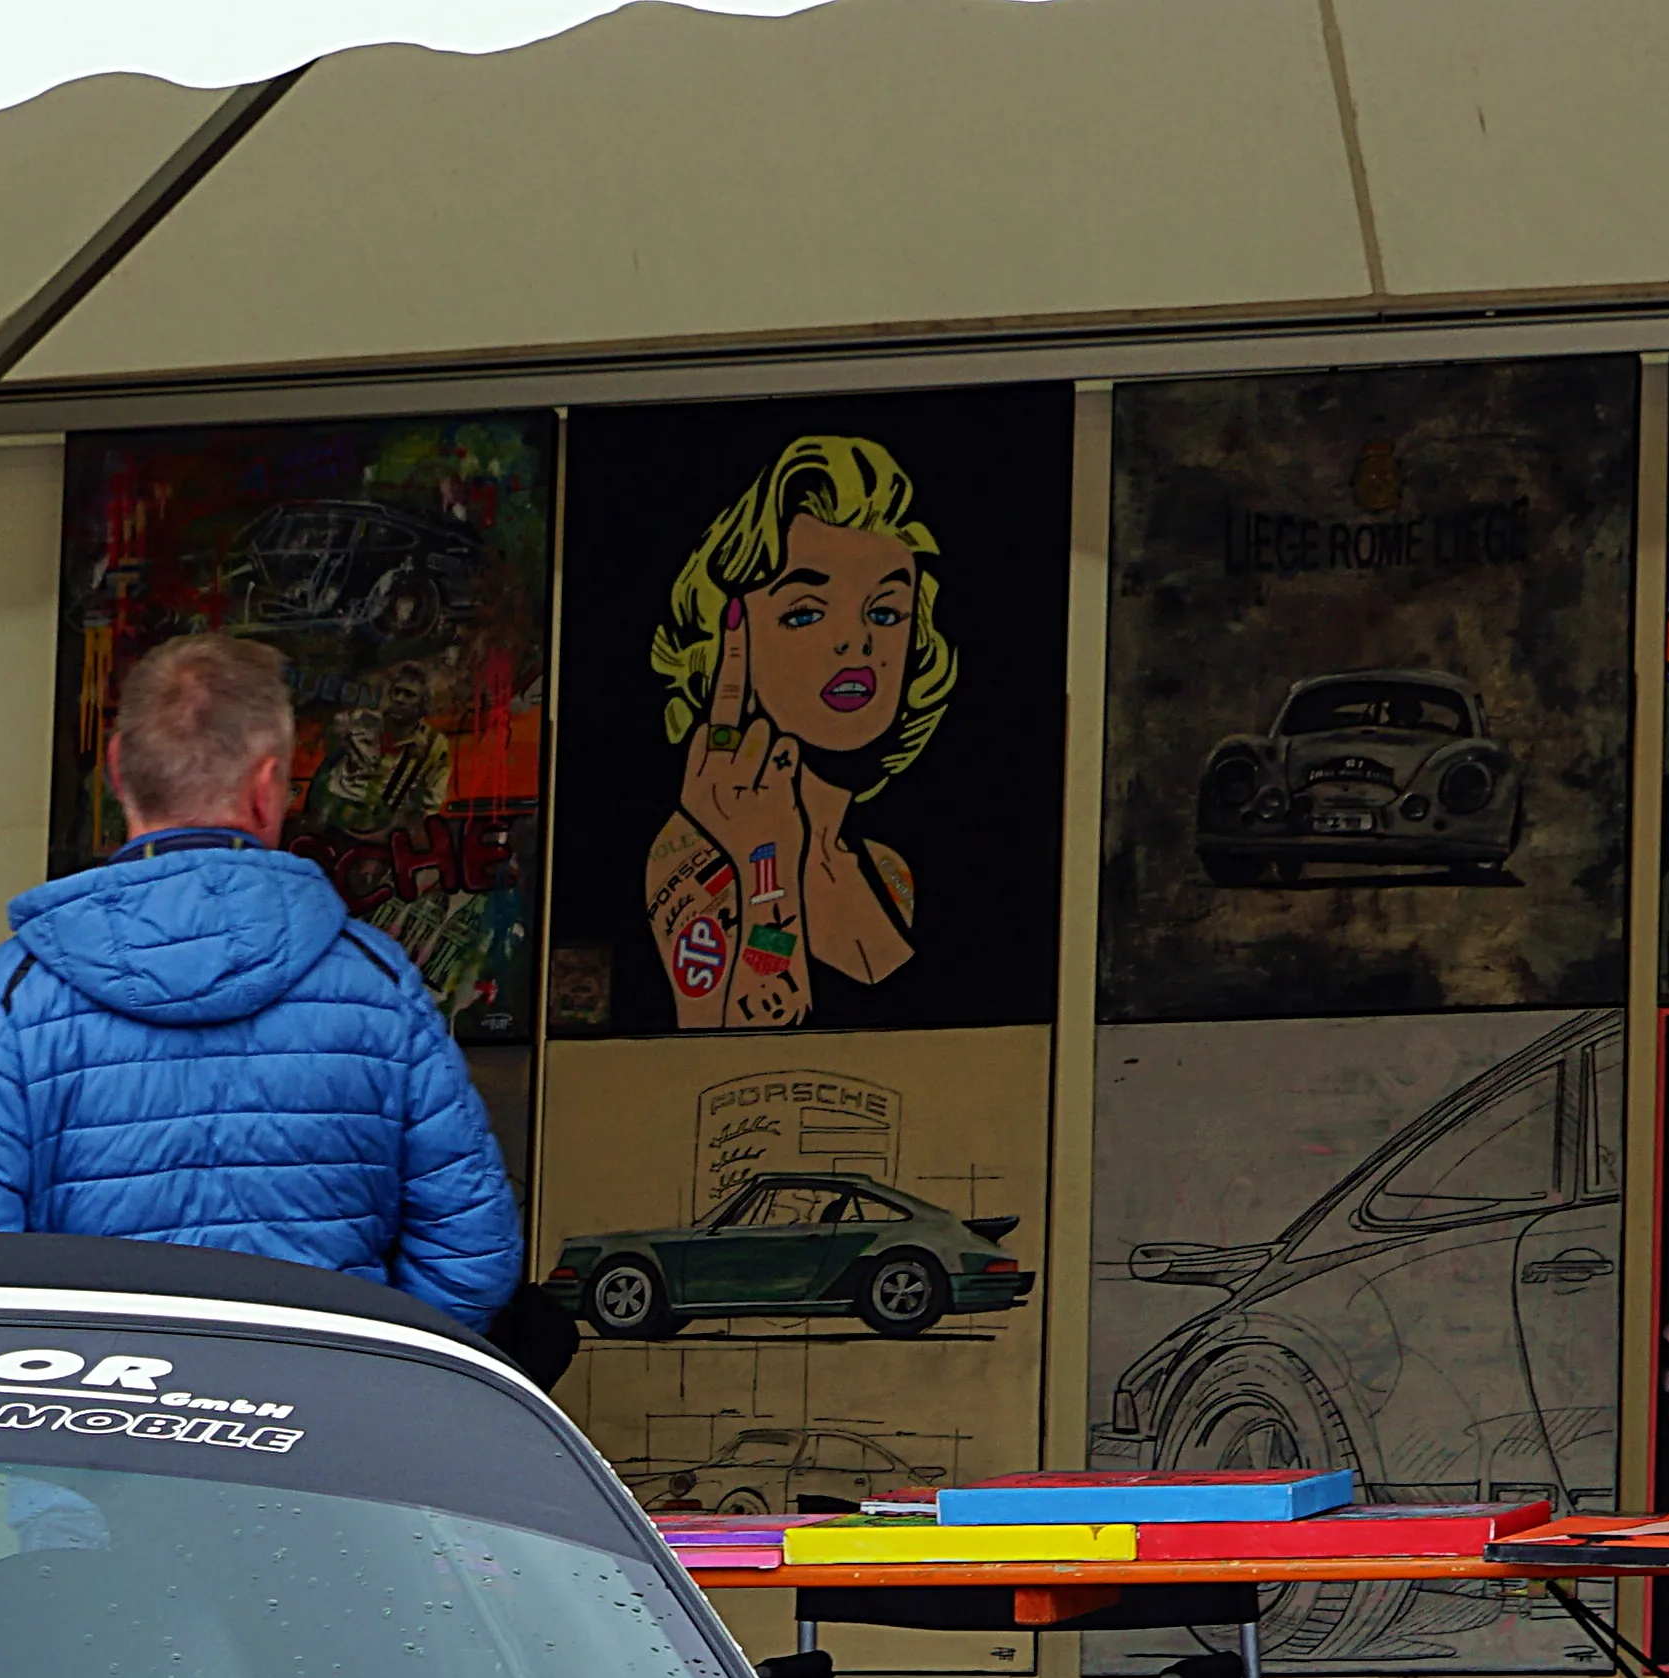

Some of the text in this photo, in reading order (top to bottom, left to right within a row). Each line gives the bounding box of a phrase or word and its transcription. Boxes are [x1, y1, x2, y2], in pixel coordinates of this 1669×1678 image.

[1226, 512, 1320, 574] LIEGE
[677, 920, 720, 990] STP
[710, 1083, 888, 1116] PORSCHE
[158, 1391, 294, 1420] GmbH
